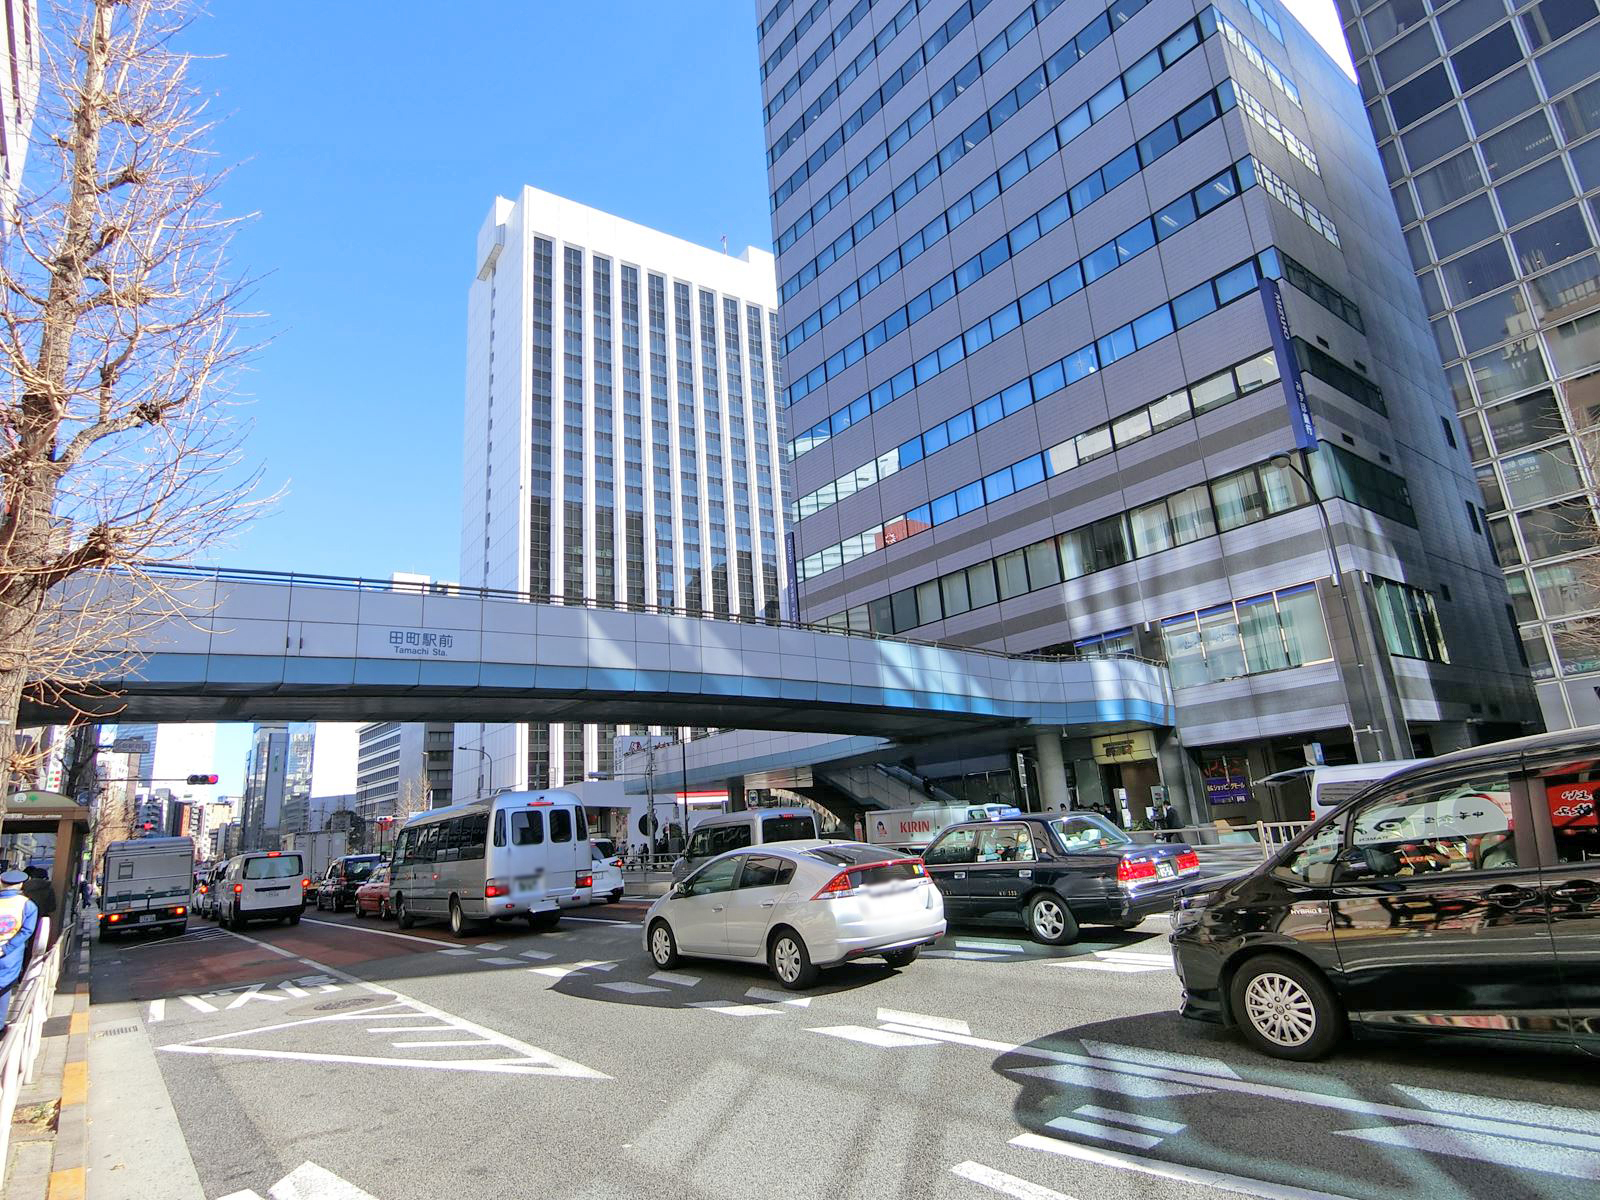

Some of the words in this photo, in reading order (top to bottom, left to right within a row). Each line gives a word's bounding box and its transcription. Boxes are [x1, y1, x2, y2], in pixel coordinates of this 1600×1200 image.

[1274, 292, 1290, 340] MIZUHO
[389, 630, 454, 649] 田町駅前
[394, 645, 429, 656] Tamachi
[432, 648, 448, 657] Sta.
[900, 820, 930, 833] KIRIN
[1290, 907, 1317, 916] HYBRID
